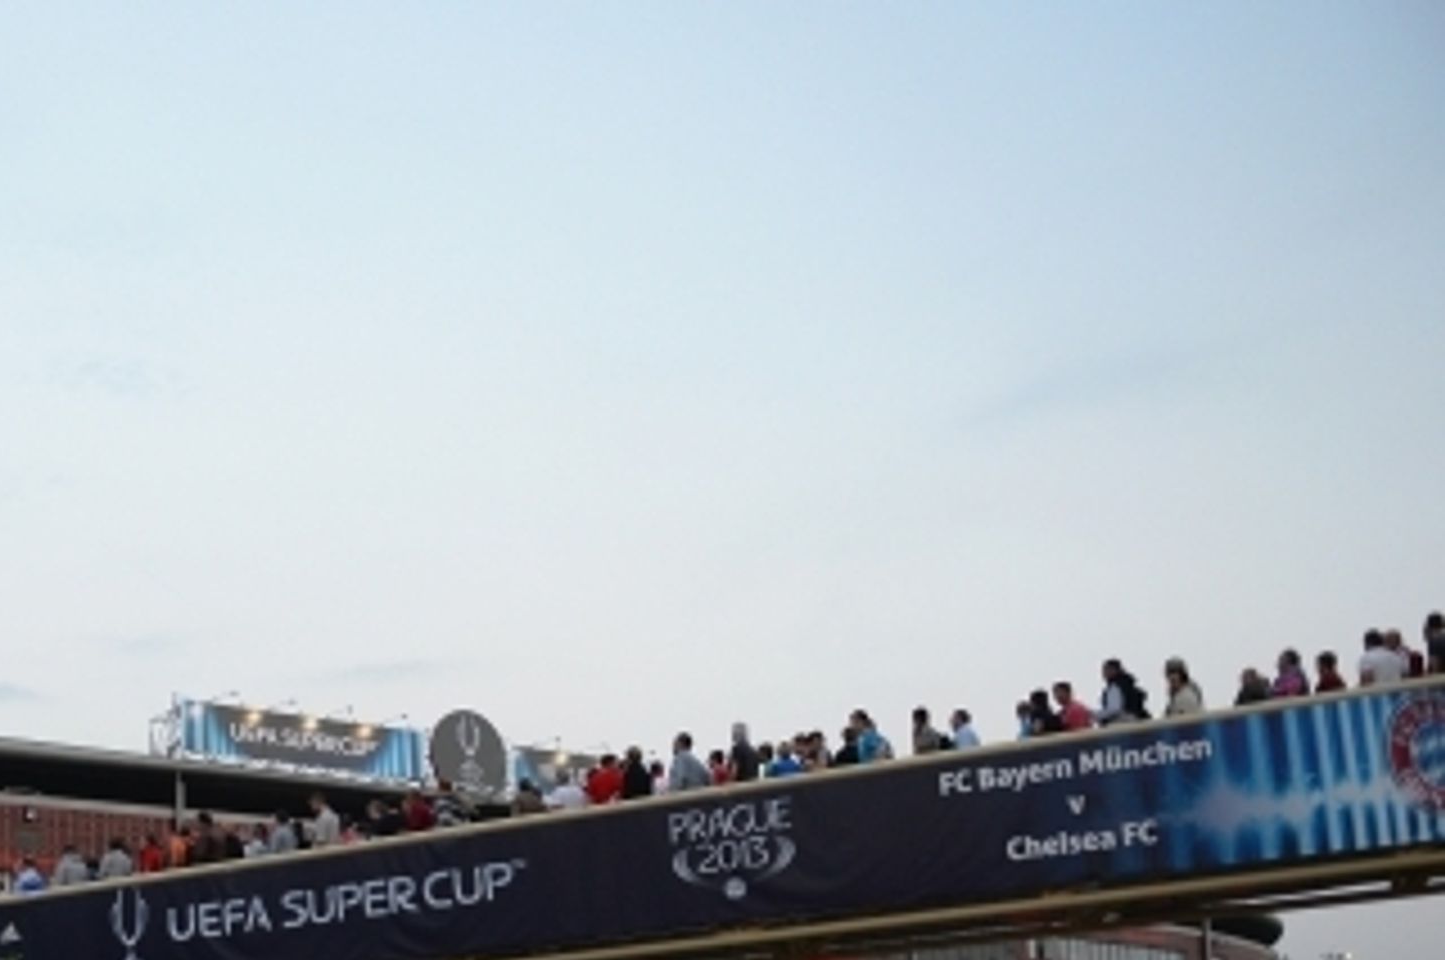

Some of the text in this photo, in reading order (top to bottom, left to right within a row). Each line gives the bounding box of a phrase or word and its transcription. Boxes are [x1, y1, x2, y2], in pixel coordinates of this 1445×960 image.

[938, 739, 1213, 796] FC Bayern München
[668, 796, 792, 845] PRAGUE
[1067, 796, 1086, 815] v
[696, 836, 770, 873] 2013
[1006, 819, 1158, 861] Chelsea FC
[167, 895, 273, 941] UEFA
[281, 876, 419, 928] SUPER
